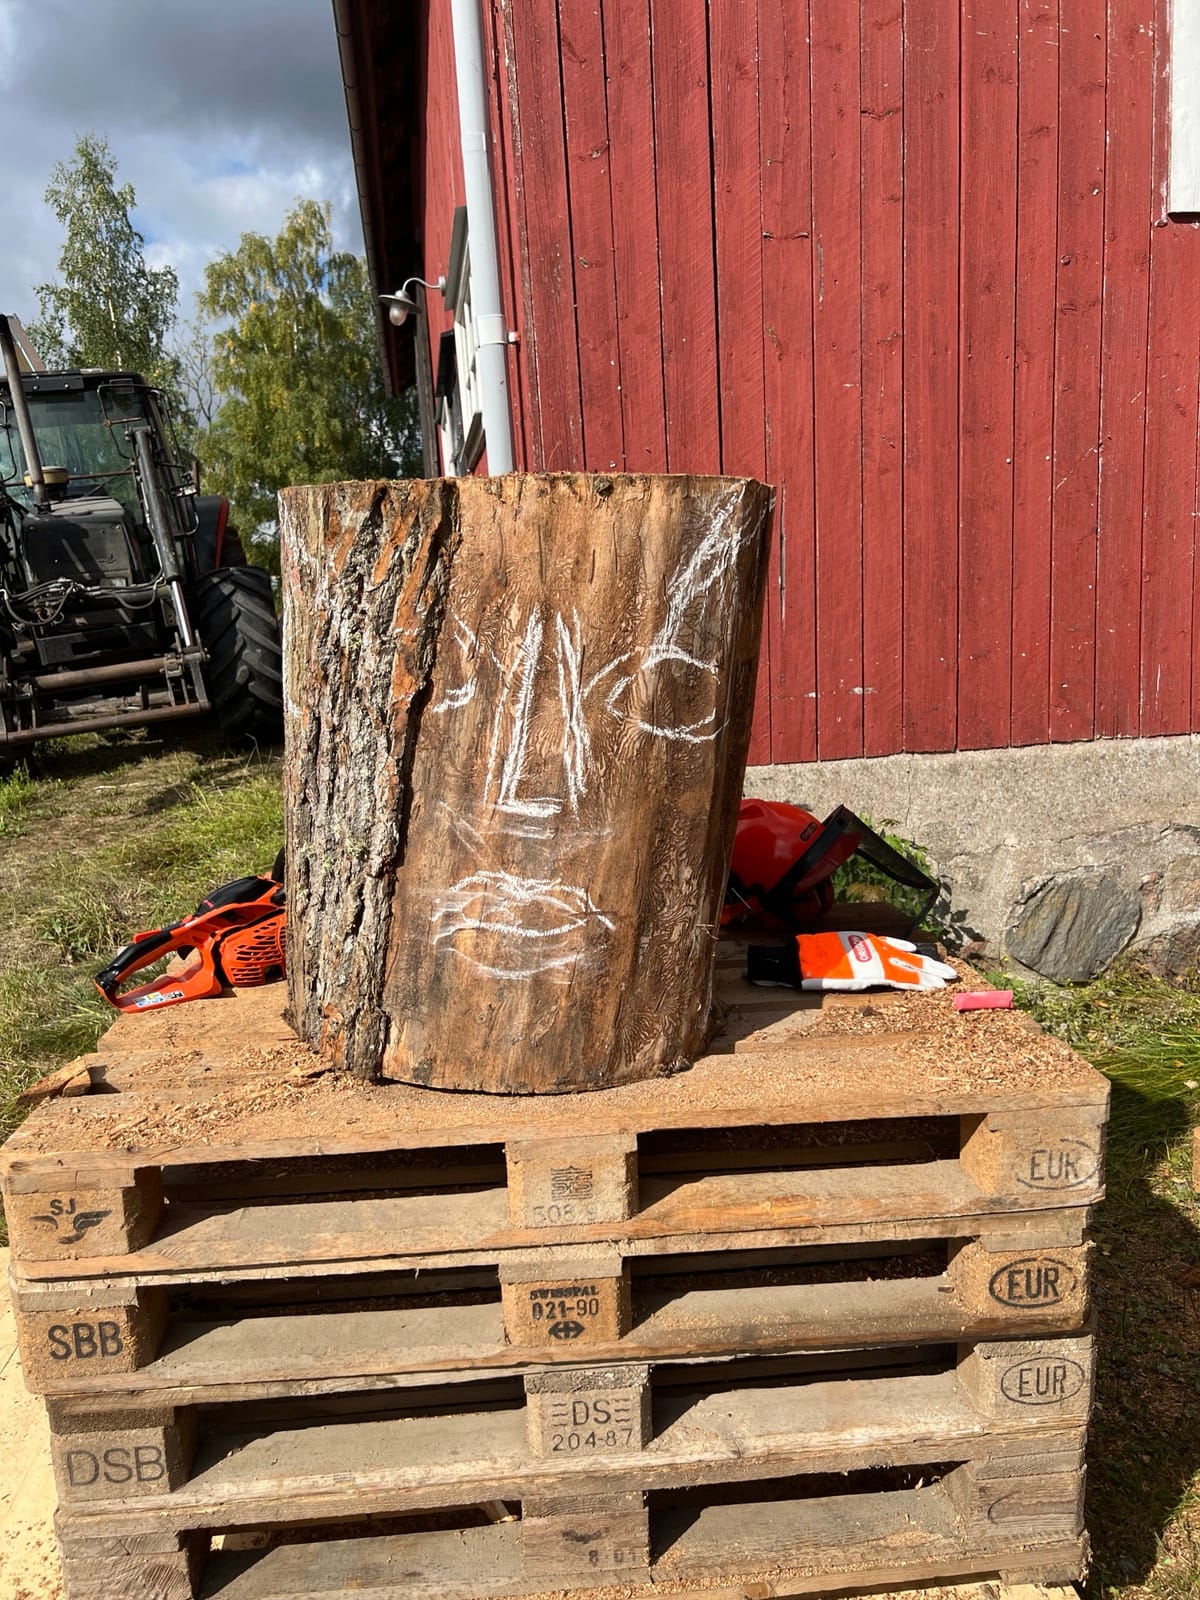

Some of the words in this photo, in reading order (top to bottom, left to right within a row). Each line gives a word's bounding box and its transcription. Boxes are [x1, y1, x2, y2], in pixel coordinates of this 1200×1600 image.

[49, 1198, 77, 1216] SJ
[1007, 1266, 1060, 1300] EUR
[532, 1298, 599, 1320] 021-90
[48, 1321, 123, 1360] SBB
[1018, 1365, 1067, 1398] EUR
[67, 1445, 166, 1487] DSB
